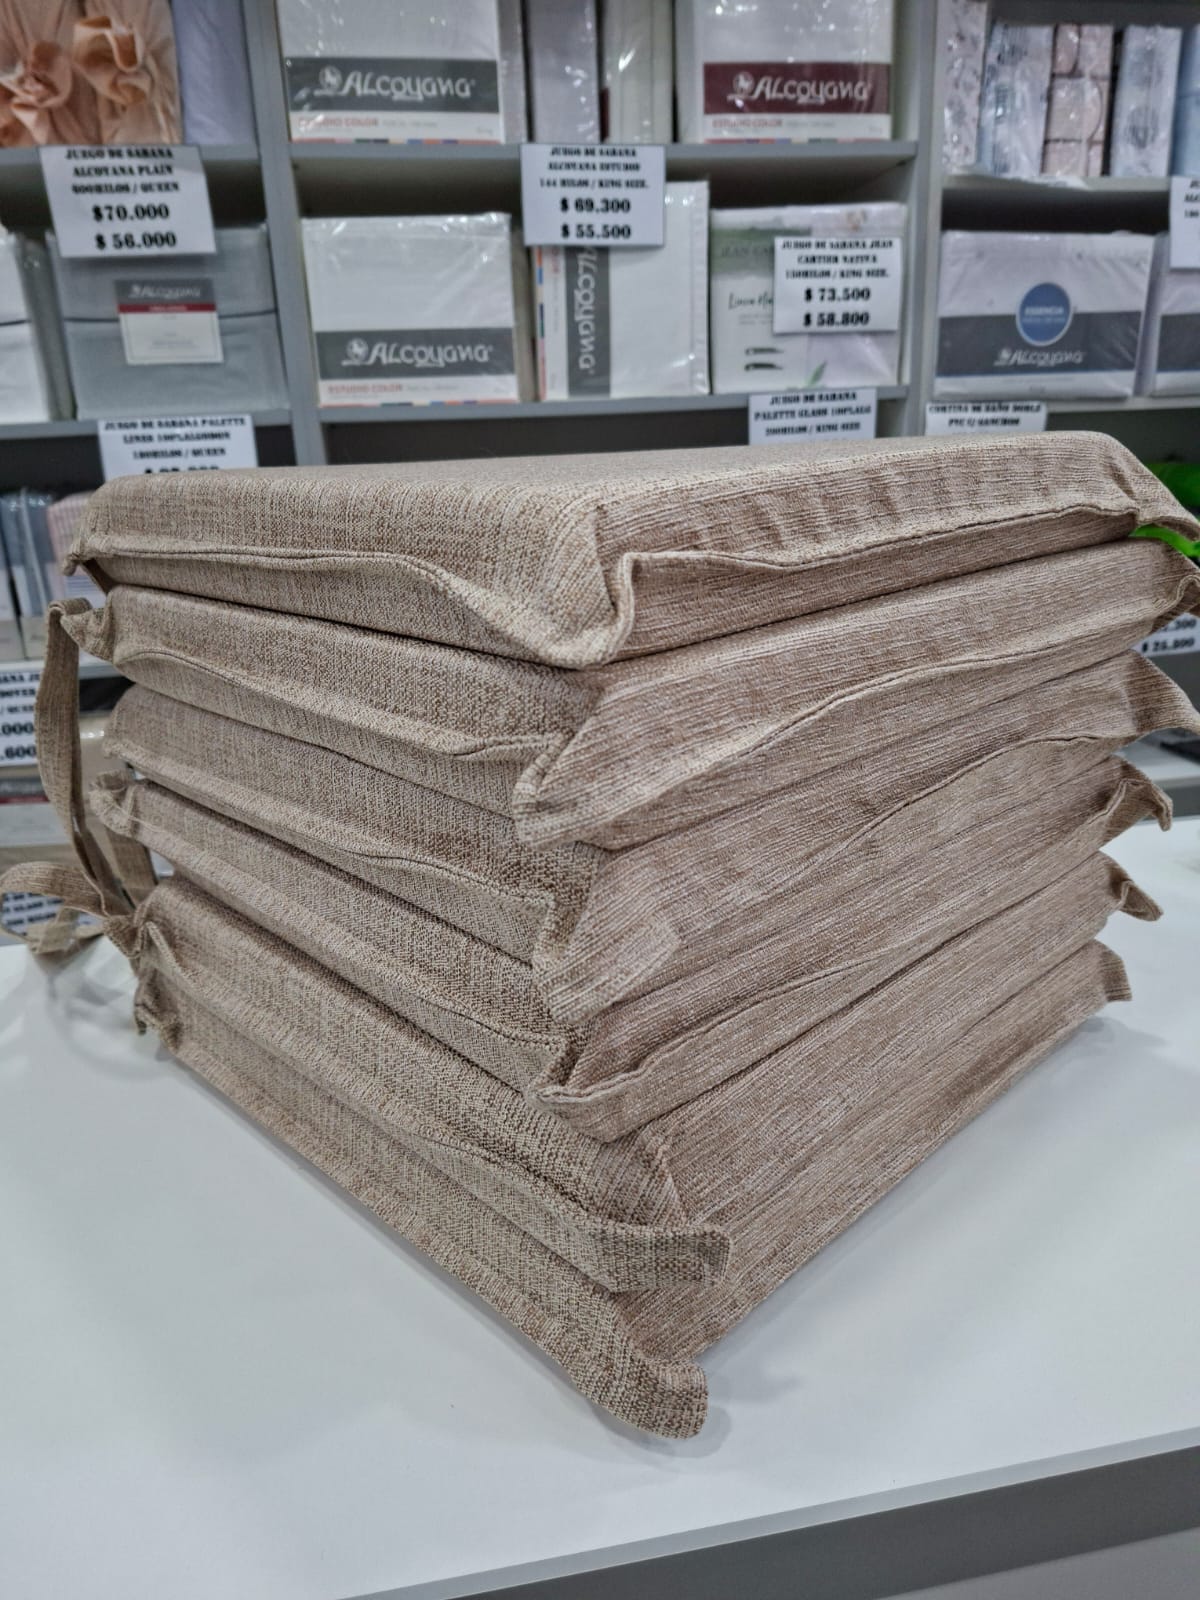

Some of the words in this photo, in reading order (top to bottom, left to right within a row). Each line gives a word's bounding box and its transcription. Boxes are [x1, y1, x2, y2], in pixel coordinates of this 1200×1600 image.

[66, 149, 105, 160] JUEGO
[108, 148, 124, 159] DE
[127, 148, 173, 159] SABANA
[551, 148, 581, 157] JUEGO
[584, 148, 596, 157] DE
[599, 148, 636, 157] SABANA
[73, 166, 134, 177] ALCOYANA
[548, 162, 597, 171] ALCOYANA
[141, 182, 179, 193] QUEEN
[598, 179, 622, 188] KING
[560, 197, 569, 213] $
[575, 198, 631, 213] 69.300
[92, 203, 169, 222] $70.000
[561, 224, 570, 239] $
[576, 224, 632, 239] 55.500
[95, 234, 106, 250] $
[113, 232, 177, 249] 56.000
[815, 240, 826, 249] DE
[804, 288, 812, 302] $
[819, 287, 871, 302] 73.500
[803, 312, 812, 327] $
[817, 312, 870, 327] 58.800
[803, 394, 816, 404] DE
[818, 392, 857, 401] SABANA
[141, 420, 154, 429] DE
